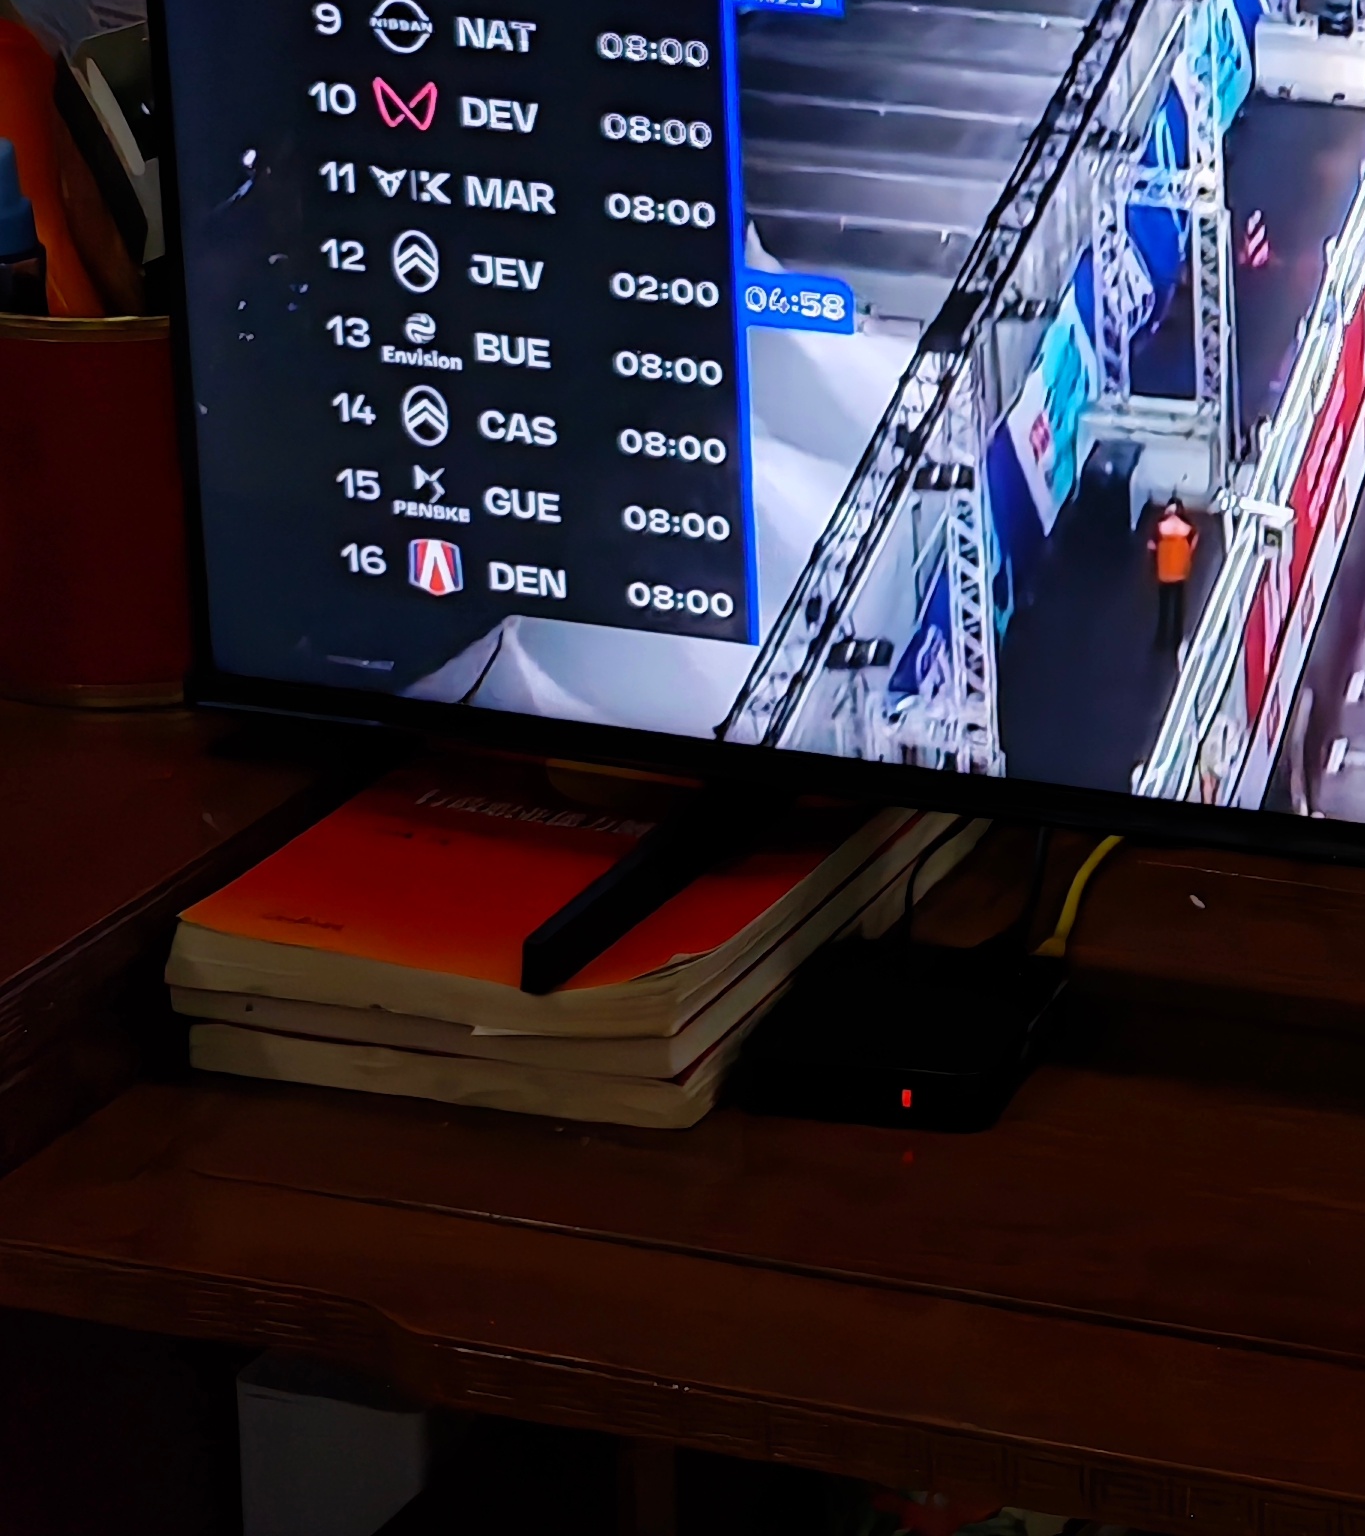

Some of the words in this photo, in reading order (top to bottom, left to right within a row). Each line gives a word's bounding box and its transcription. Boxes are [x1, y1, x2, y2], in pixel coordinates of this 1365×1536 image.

[314, 3, 341, 34] 9
[457, 17, 536, 52] NAT
[598, 33, 708, 67] 08:00
[309, 82, 356, 114] 10
[461, 96, 538, 133] DEV
[602, 113, 712, 149] 08:00
[320, 162, 355, 193] 11
[466, 176, 556, 214] MAR
[607, 193, 715, 228] 08:00
[321, 239, 365, 271] 12
[470, 254, 544, 289] JEV
[610, 273, 719, 307] 02:00
[746, 287, 845, 320] 04:58
[326, 316, 370, 347] 13
[475, 333, 551, 368] BUE
[615, 351, 722, 385] 08:00
[382, 346, 462, 370] Envision
[333, 393, 376, 424] 14
[479, 410, 557, 445] CAS
[620, 429, 726, 463] 08:00
[336, 469, 380, 500] 15
[484, 487, 561, 522] GUE
[623, 506, 729, 540] 08:00
[341, 543, 386, 574] 16
[489, 562, 566, 598] DEN
[627, 582, 733, 617] 08:00
